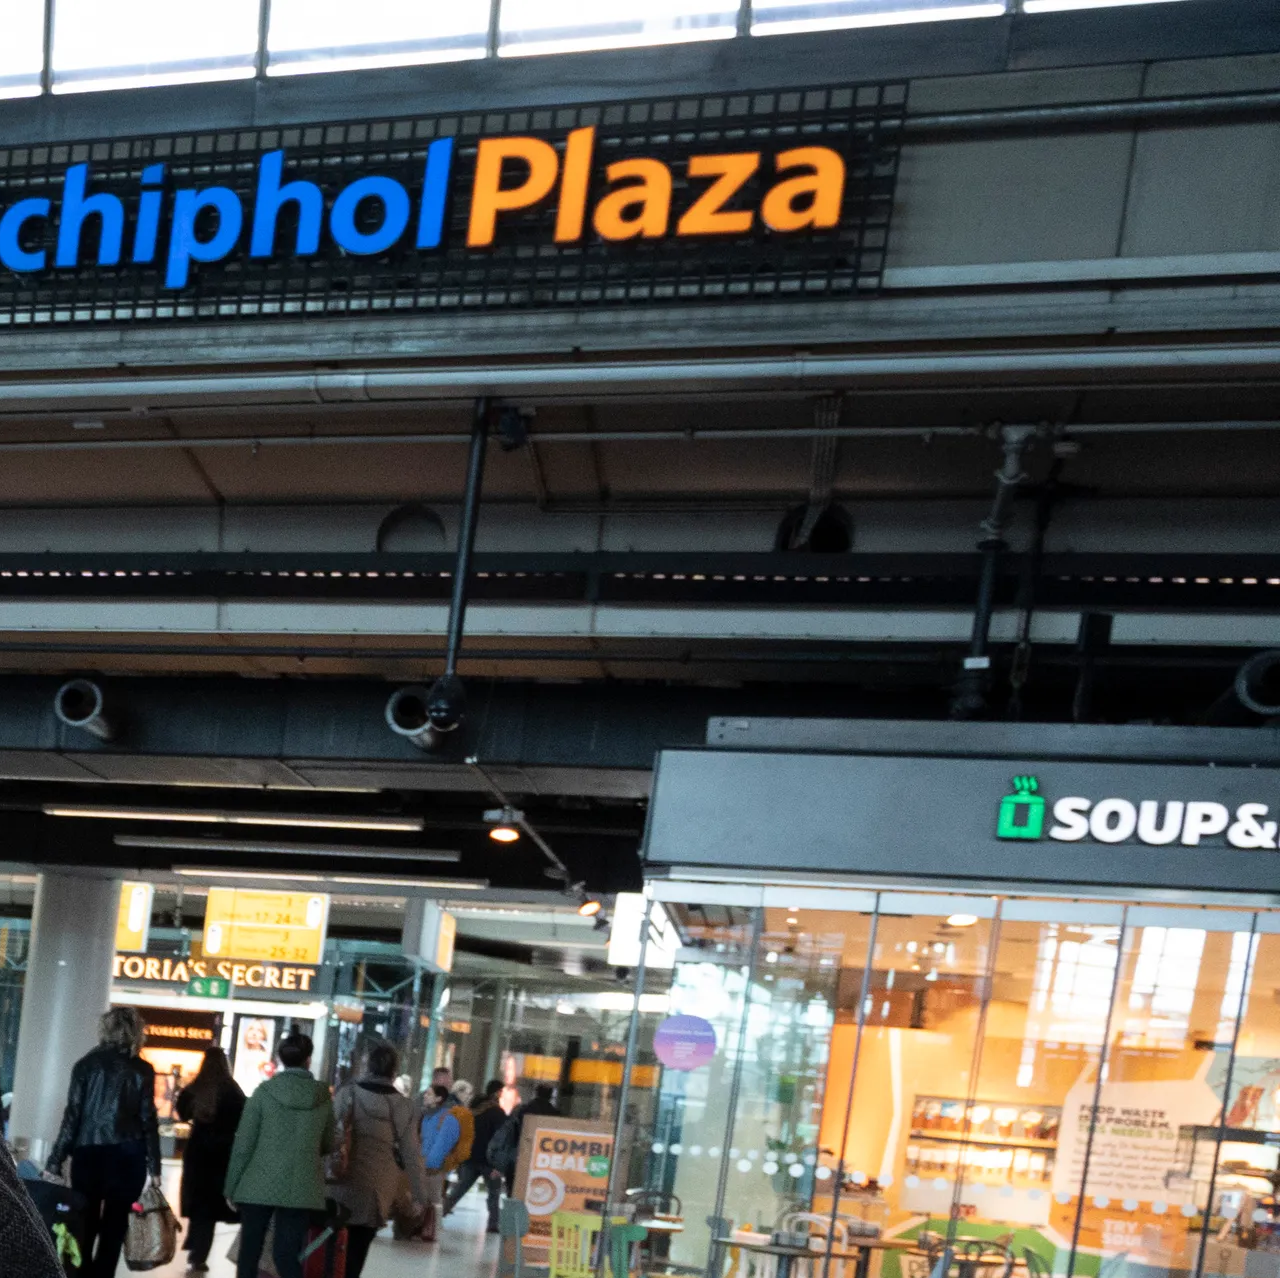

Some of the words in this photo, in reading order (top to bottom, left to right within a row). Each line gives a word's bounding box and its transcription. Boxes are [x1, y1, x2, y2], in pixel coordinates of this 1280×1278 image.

[466, 125, 846, 248] Plaza
[1049, 796, 1280, 849] SOUP&
[112, 956, 207, 982] TORIA'S
[216, 961, 316, 991] SECRET
[536, 1153, 588, 1173] DEAL
[539, 1137, 611, 1158] COMBI
